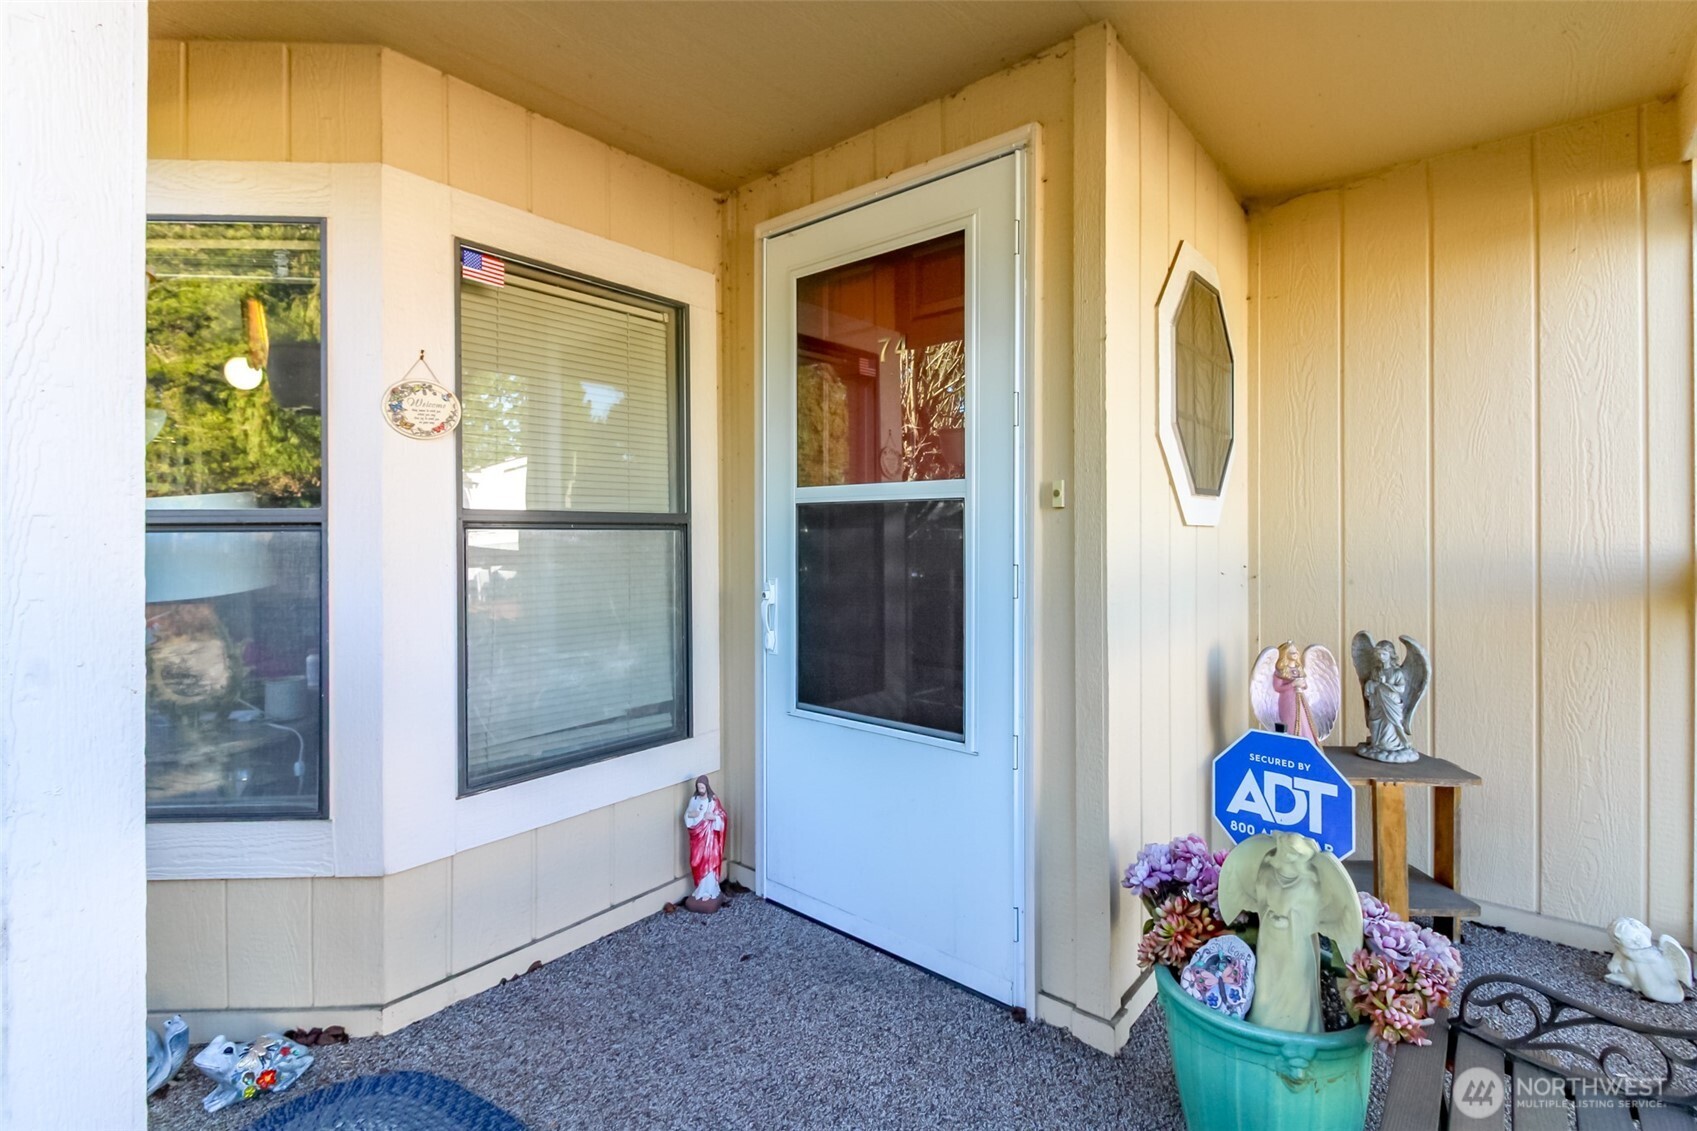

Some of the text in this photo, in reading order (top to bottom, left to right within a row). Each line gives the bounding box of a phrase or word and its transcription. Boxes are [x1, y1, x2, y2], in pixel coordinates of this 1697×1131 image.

[407, 398, 446, 408] Welcome
[1249, 753, 1311, 771] SECURED BY
[1226, 768, 1338, 834] ADT
[1230, 820, 1255, 835] 800
